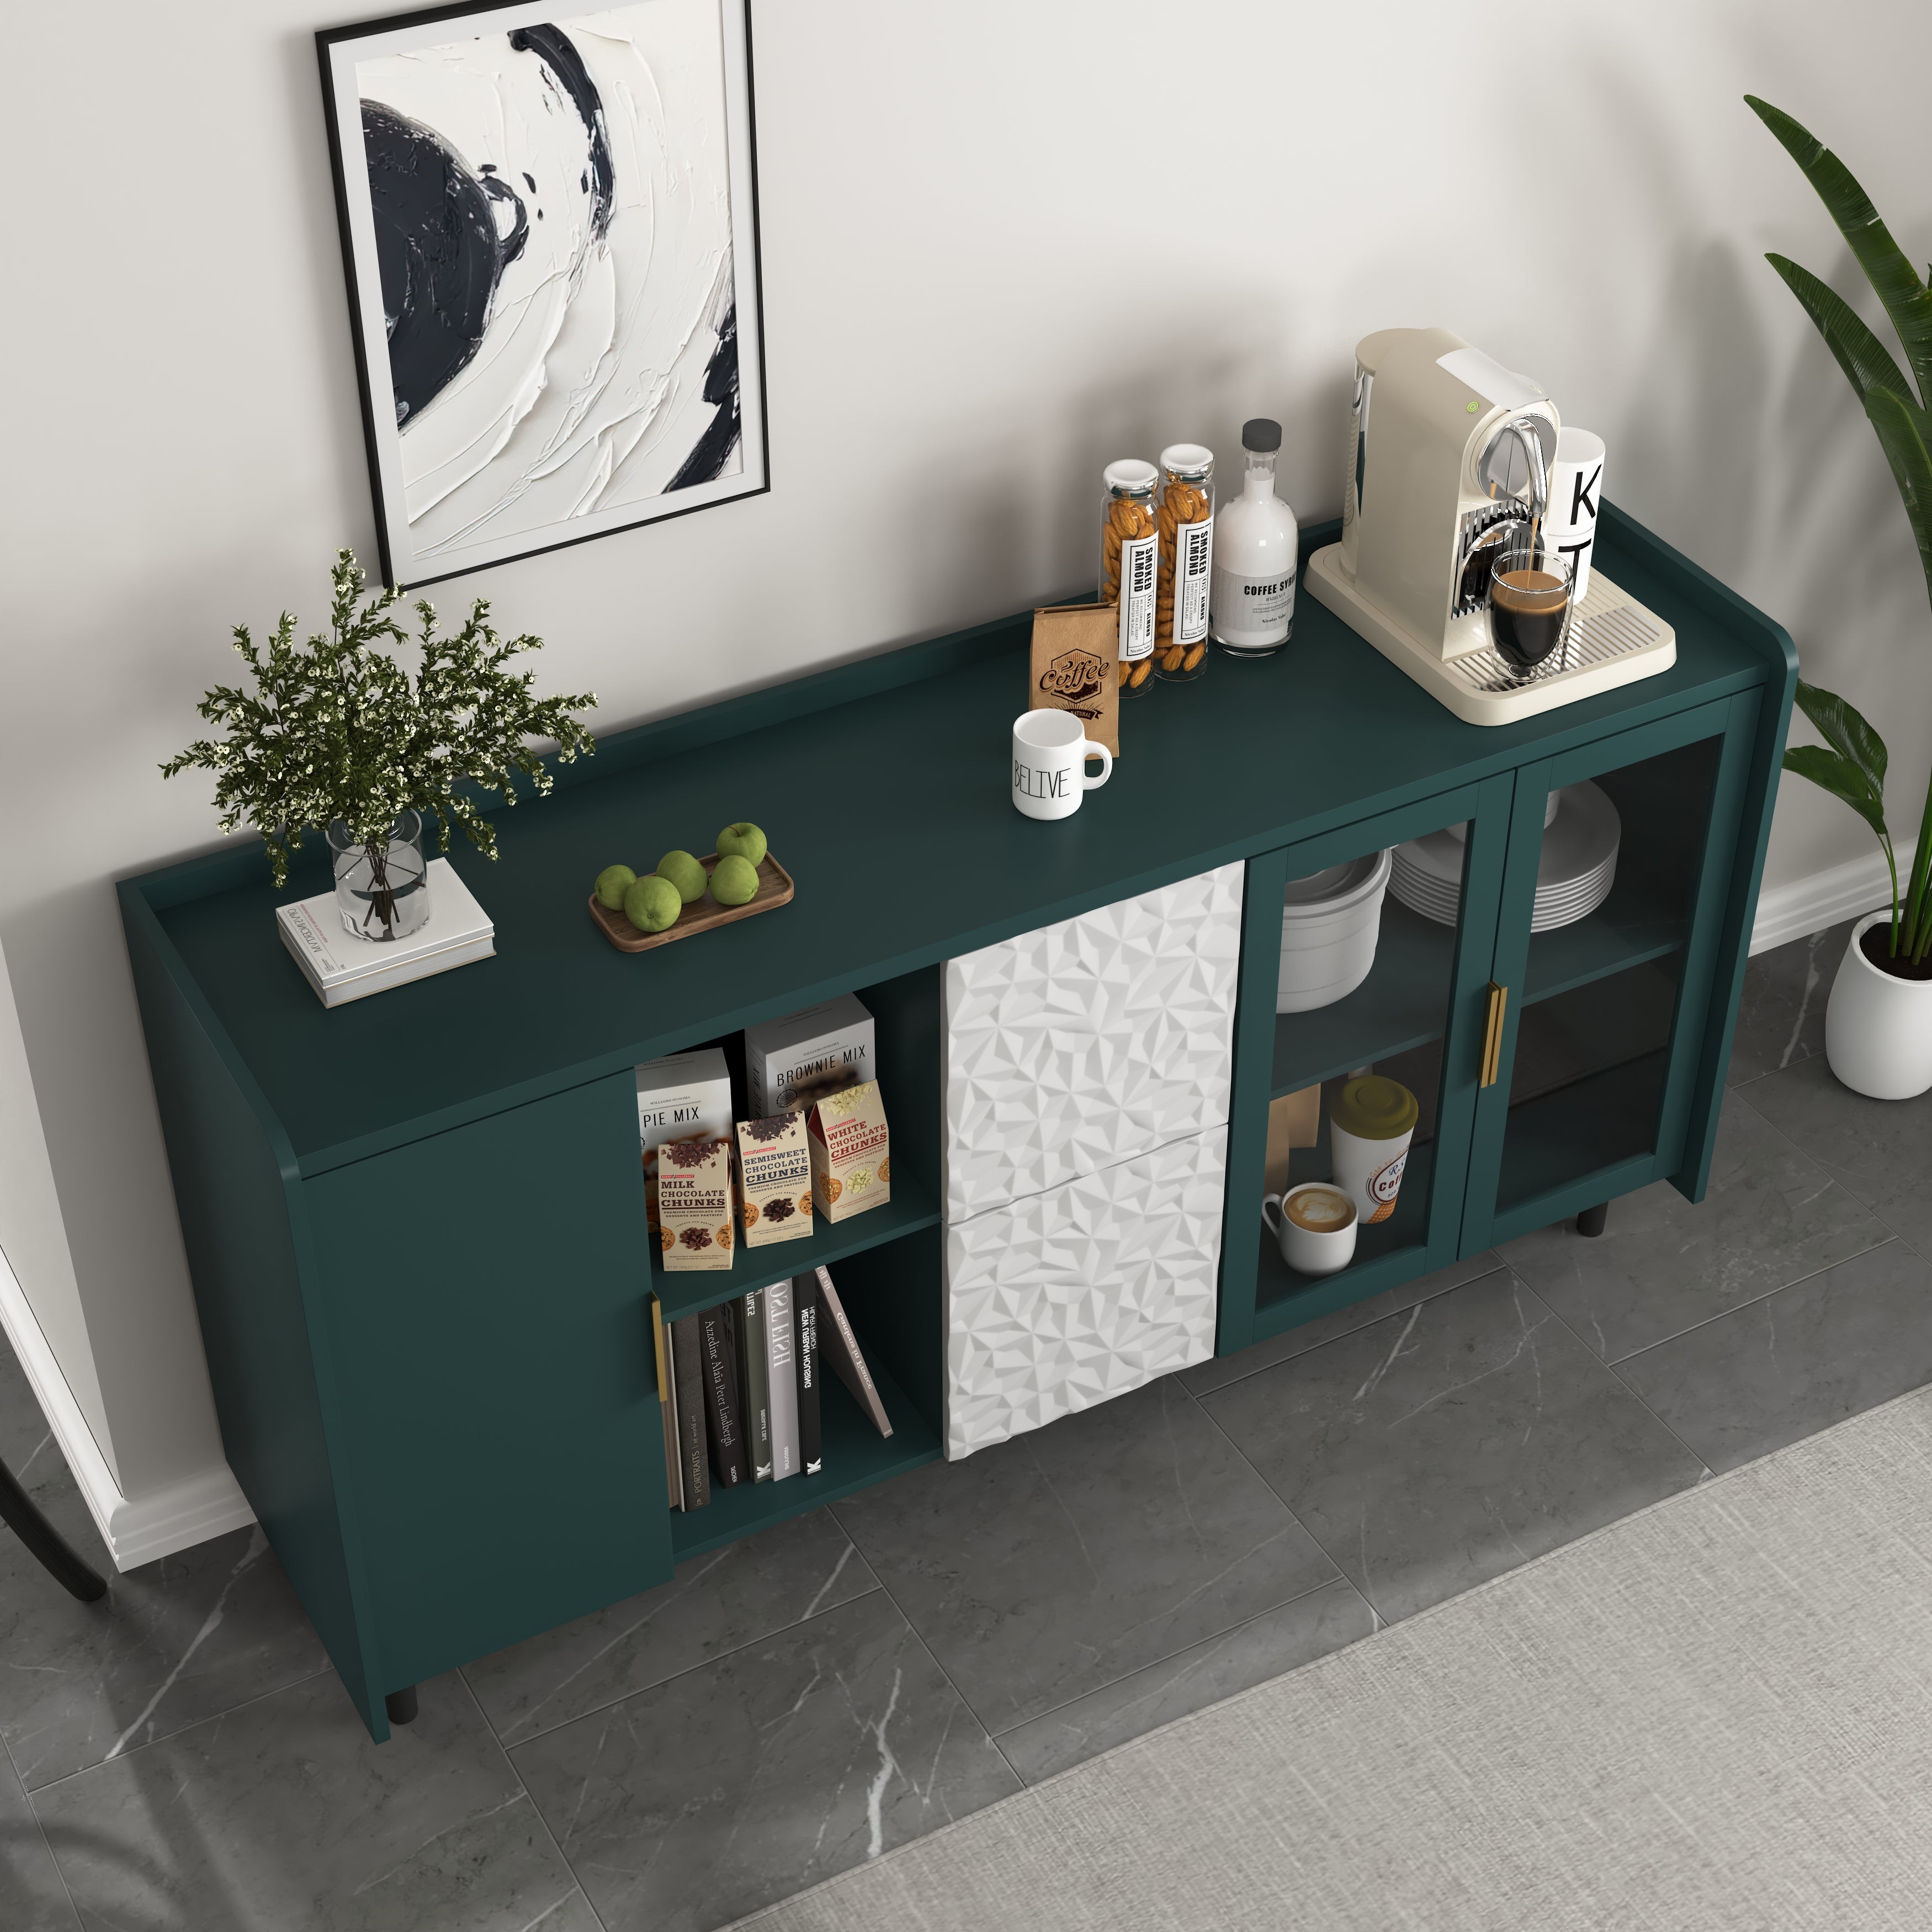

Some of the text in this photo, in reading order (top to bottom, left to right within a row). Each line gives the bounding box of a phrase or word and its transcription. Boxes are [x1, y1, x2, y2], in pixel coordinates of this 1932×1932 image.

[1569, 463, 1602, 526] K
[1189, 534, 1200, 576] ALMOND
[1199, 530, 1208, 574] SMOKED
[1134, 551, 1145, 592] ALMOND
[1144, 546, 1153, 590] SMOKED
[1558, 538, 1591, 596] T
[1202, 578, 1207, 591] 03
[1244, 583, 1277, 596] COFFEE
[1147, 595, 1152, 607] 03
[1039, 660, 1109, 690] Coffee
[1015, 760, 1071, 798] BELIVE
[777, 1044, 866, 1087] BROWNIE MIX
[644, 1106, 699, 1128] PIE MIX
[827, 1121, 867, 1141] WHITE
[830, 1123, 886, 1150] CHOCOLATE
[744, 1148, 806, 1166] SEMISWEET
[831, 1132, 887, 1158] CHUNKS
[833, 1156, 852, 1165] PREMIUM
[853, 1147, 877, 1158] CHOCOLATE
[745, 1156, 808, 1174] CHOCOLATE
[834, 1159, 855, 1169] DESSERTS
[865, 1148, 884, 1157] PASTRIES
[746, 1165, 808, 1183] CHUNKS
[771, 1178, 797, 1186] CHOCOLATE
[661, 1198, 725, 1207] CHUNKS
[705, 1321, 736, 1447] Azzedine Alaïa Peter Lindbergh
[692, 1451, 702, 1494] PORTRAITS
